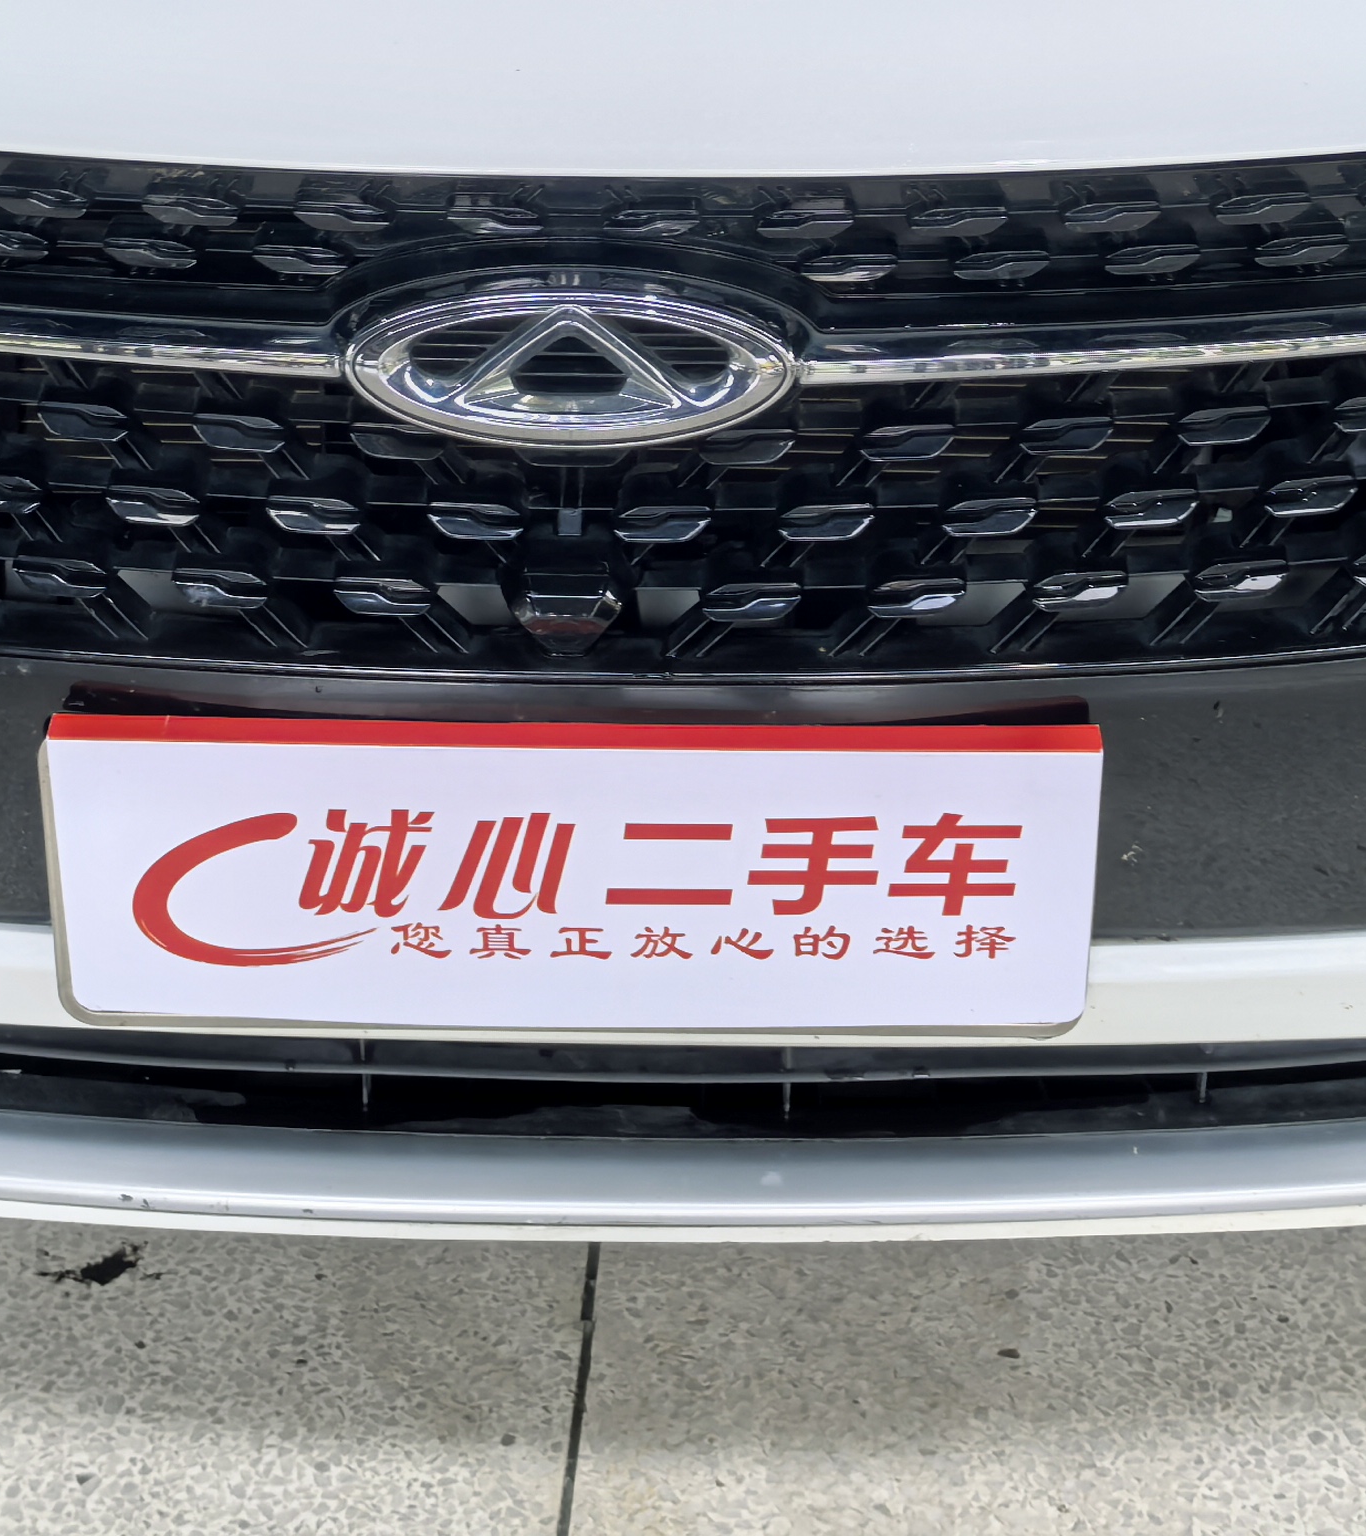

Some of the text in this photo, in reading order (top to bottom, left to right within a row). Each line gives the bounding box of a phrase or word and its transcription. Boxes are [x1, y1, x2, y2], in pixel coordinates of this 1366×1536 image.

[296, 808, 1023, 919] 诚心二手车
[389, 922, 1018, 962] 您真正放心的选择
